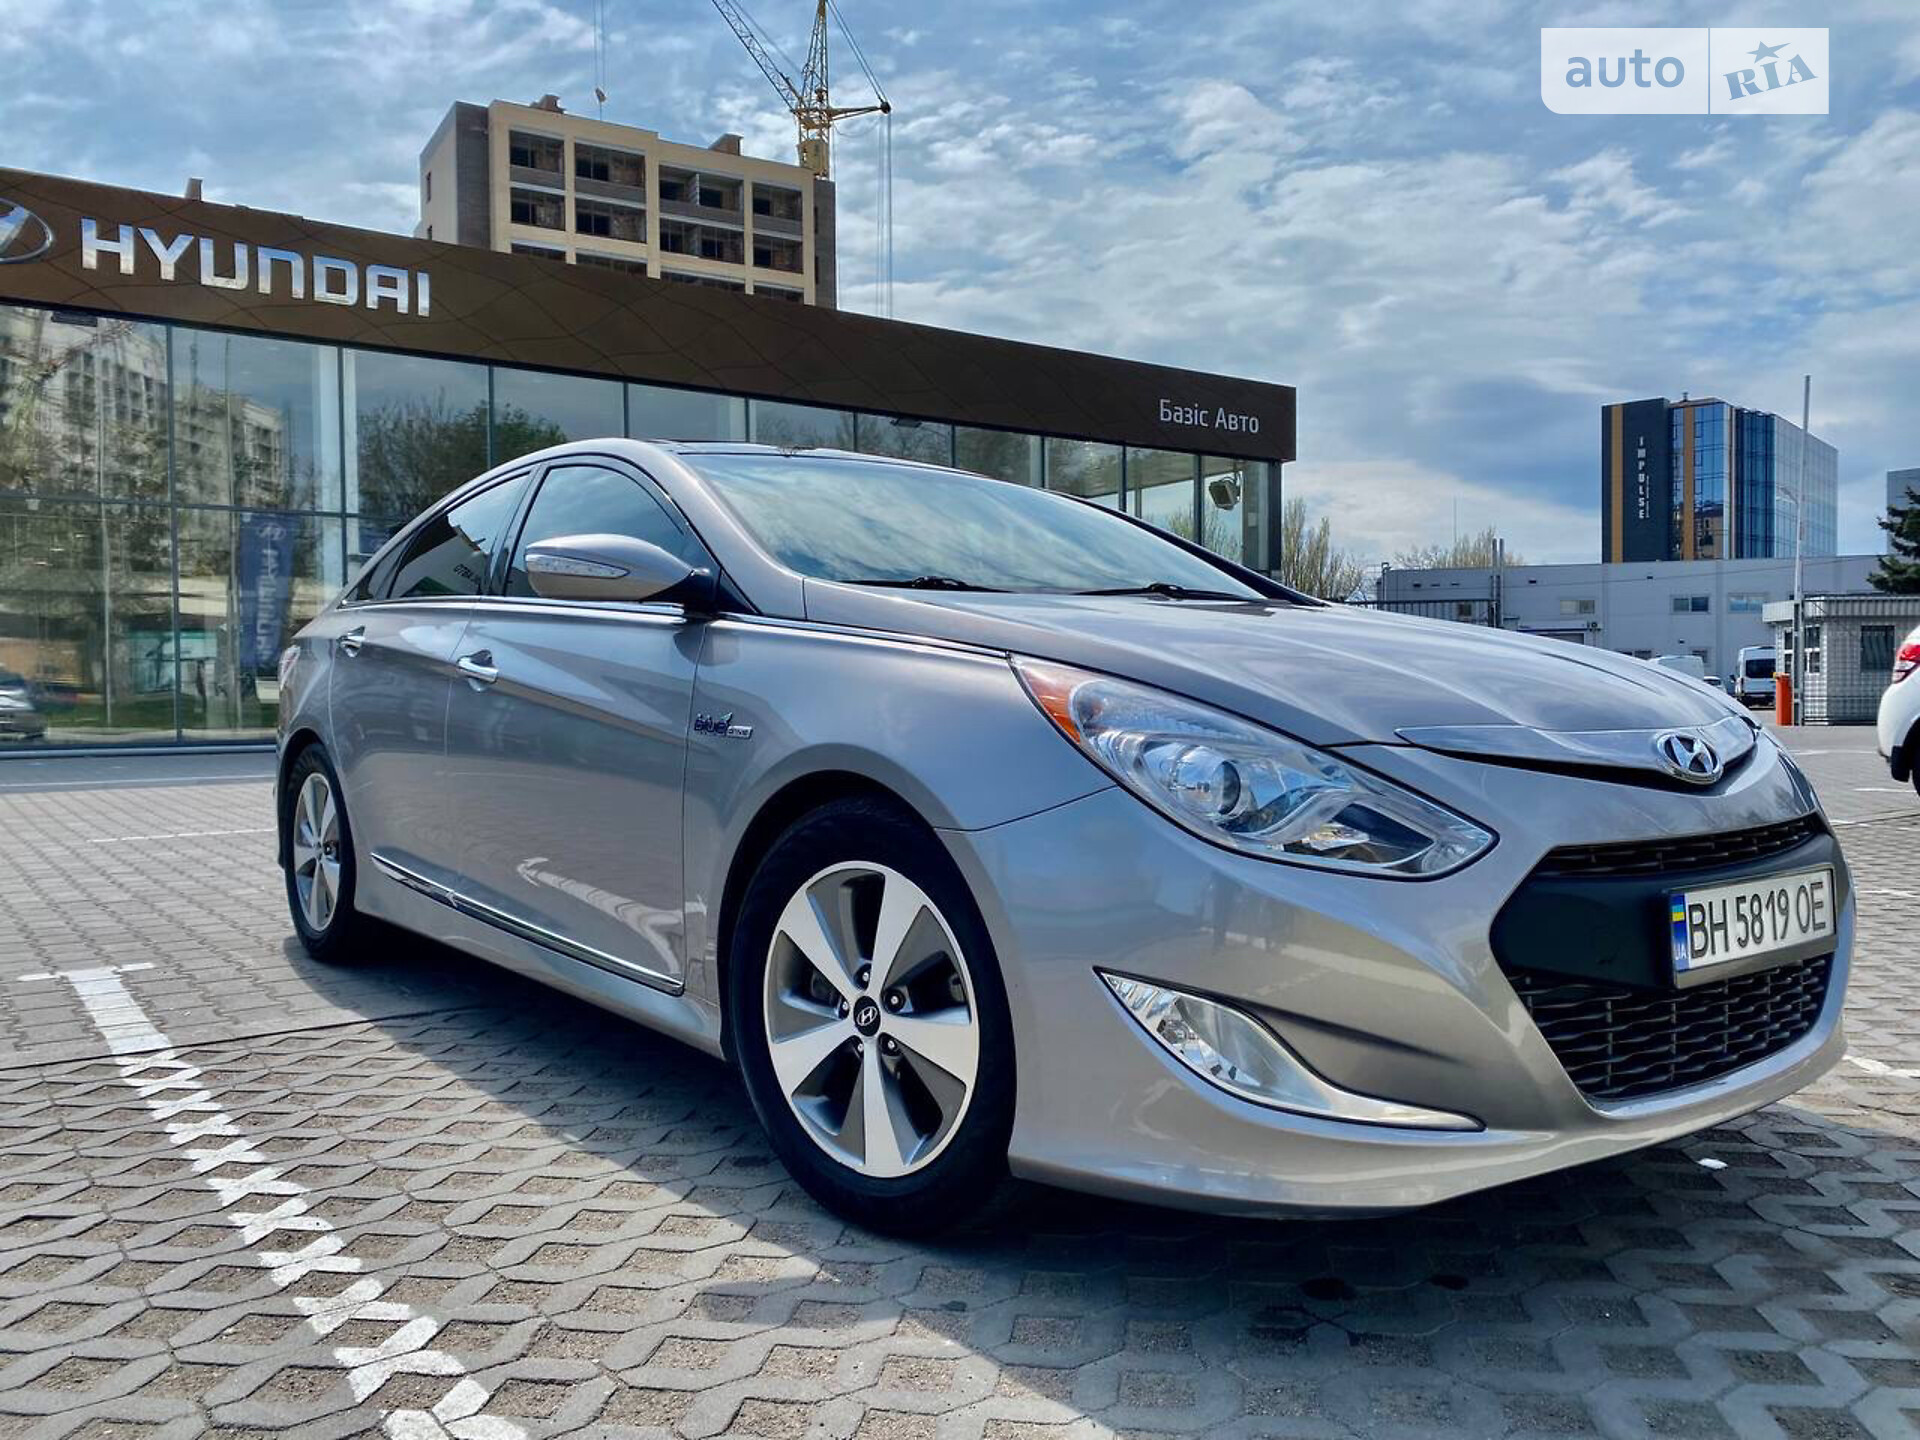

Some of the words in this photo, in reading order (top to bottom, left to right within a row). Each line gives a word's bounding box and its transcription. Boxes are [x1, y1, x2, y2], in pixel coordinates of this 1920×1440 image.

[81, 217, 430, 318] HYUNDAI
[1159, 398, 1209, 427] Базіс
[1215, 407, 1259, 434] Авто
[1637, 435, 1646, 519] IMPULSE
[1688, 899, 1730, 959] BH
[1735, 888, 1789, 949] 5819
[1796, 881, 1826, 934] OE
